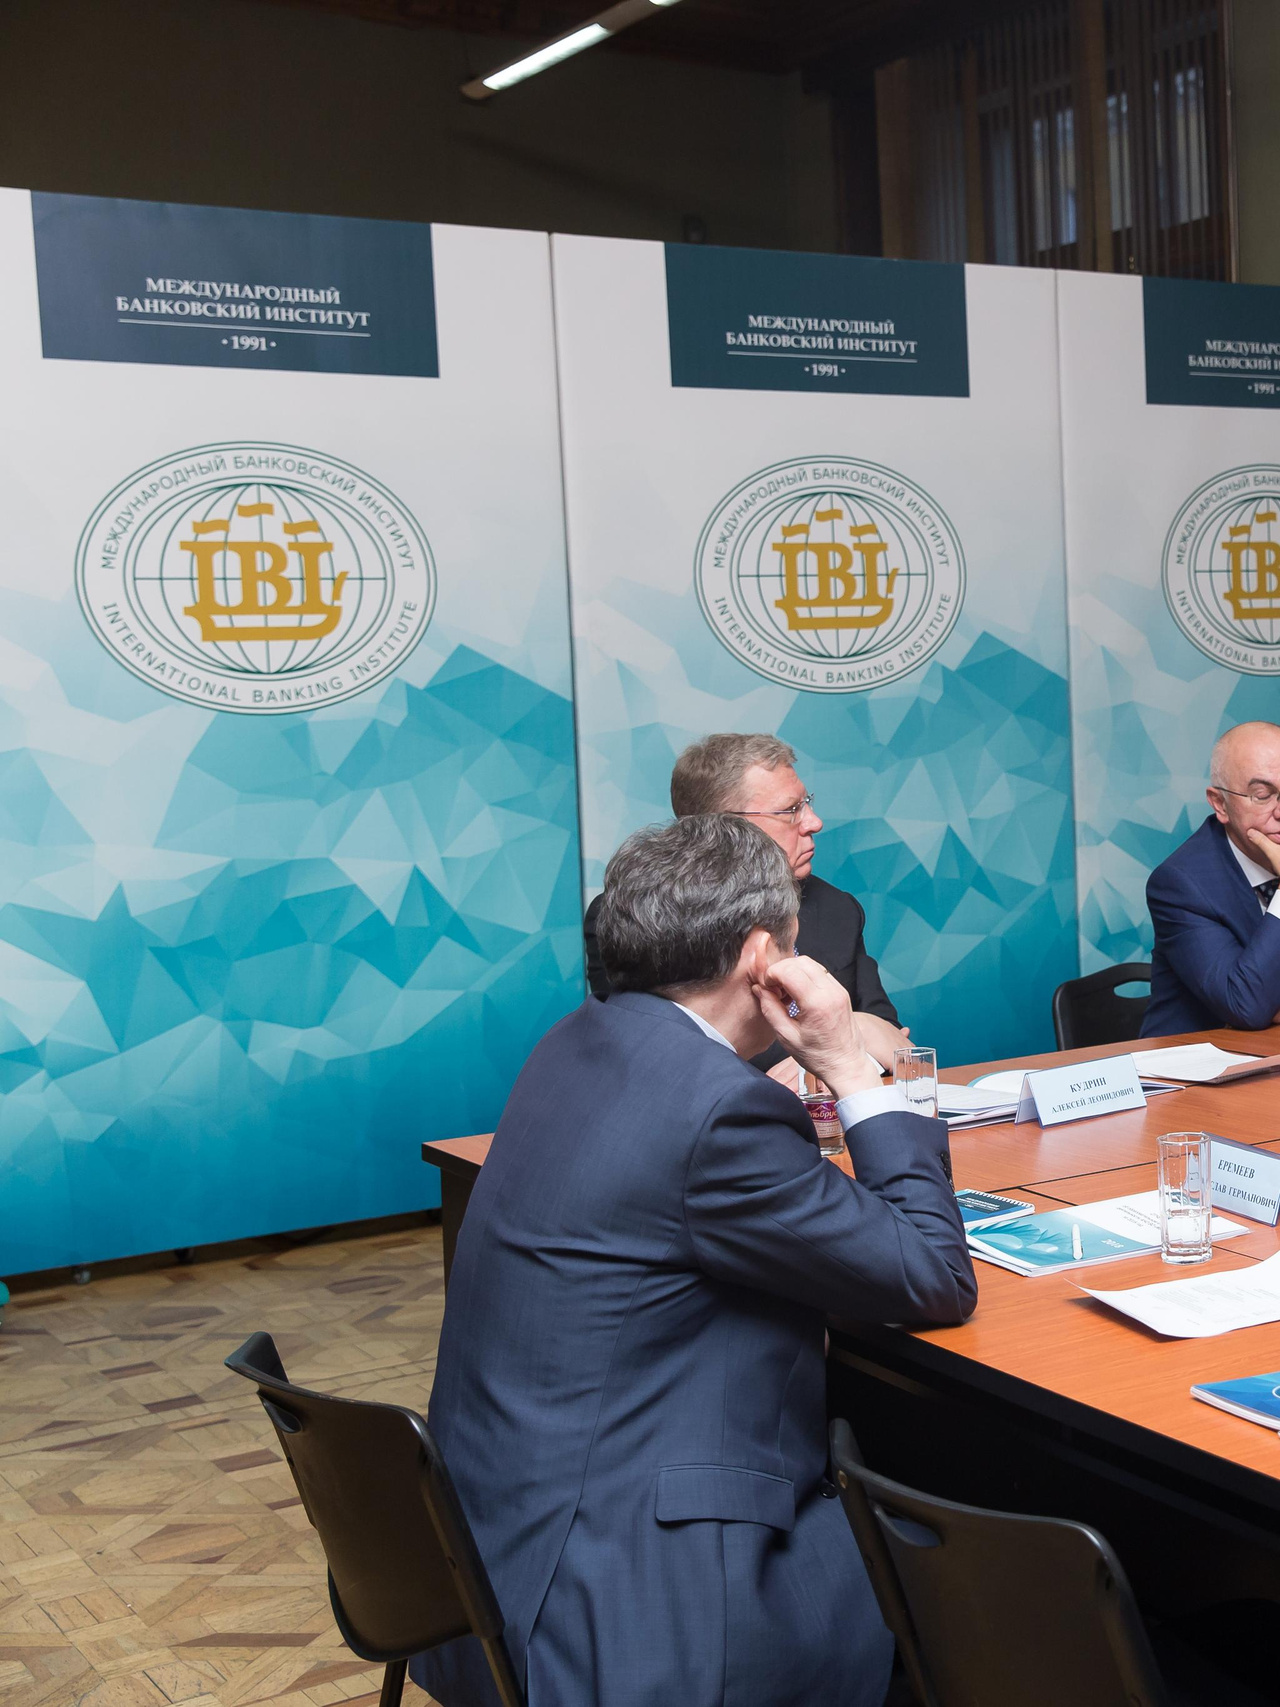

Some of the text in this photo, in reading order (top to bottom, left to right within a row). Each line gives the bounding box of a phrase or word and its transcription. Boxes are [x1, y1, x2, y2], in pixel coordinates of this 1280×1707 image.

[146, 277, 341, 304] МЕЖДУНАРОДНЫЙ
[116, 296, 371, 329] БАНКОВСКИЙ ИНСТИТУТ
[748, 315, 895, 335] МЕЖДУНАРОДНЫЙ
[726, 331, 918, 357] БАНКОВСКИЙ ИНСТИТУТ
[1188, 354, 1271, 371] БАНКОВСКИЙ
[101, 455, 415, 571] МЕЖДУНАРОДНЫЙ БАНКОВСКИЙ ИНСТИТУТ
[714, 467, 950, 568] МЕЖДУНАРОДНЫЙ БАНКОВСКИЙ ИНСТИТУТ
[1176, 475, 1250, 564] МЕЖДУНАРОДНЫЙ
[714, 593, 952, 684] INTERNATIONAL BANKING INSTITUTE
[1176, 590, 1256, 666] INTERNATIONAL
[103, 600, 418, 704] INTERNATIONAL BANKING INSTITUTE
[1069, 1077, 1107, 1093] КУДРИН
[1051, 1087, 1135, 1114] АЛЕКСЕЙ ЛЕОНИДОВИЧ
[1217, 1159, 1256, 1179] ЕРЕМЕЕВ
[1228, 1187, 1277, 1210] ГЕРМАНОВИЧ
